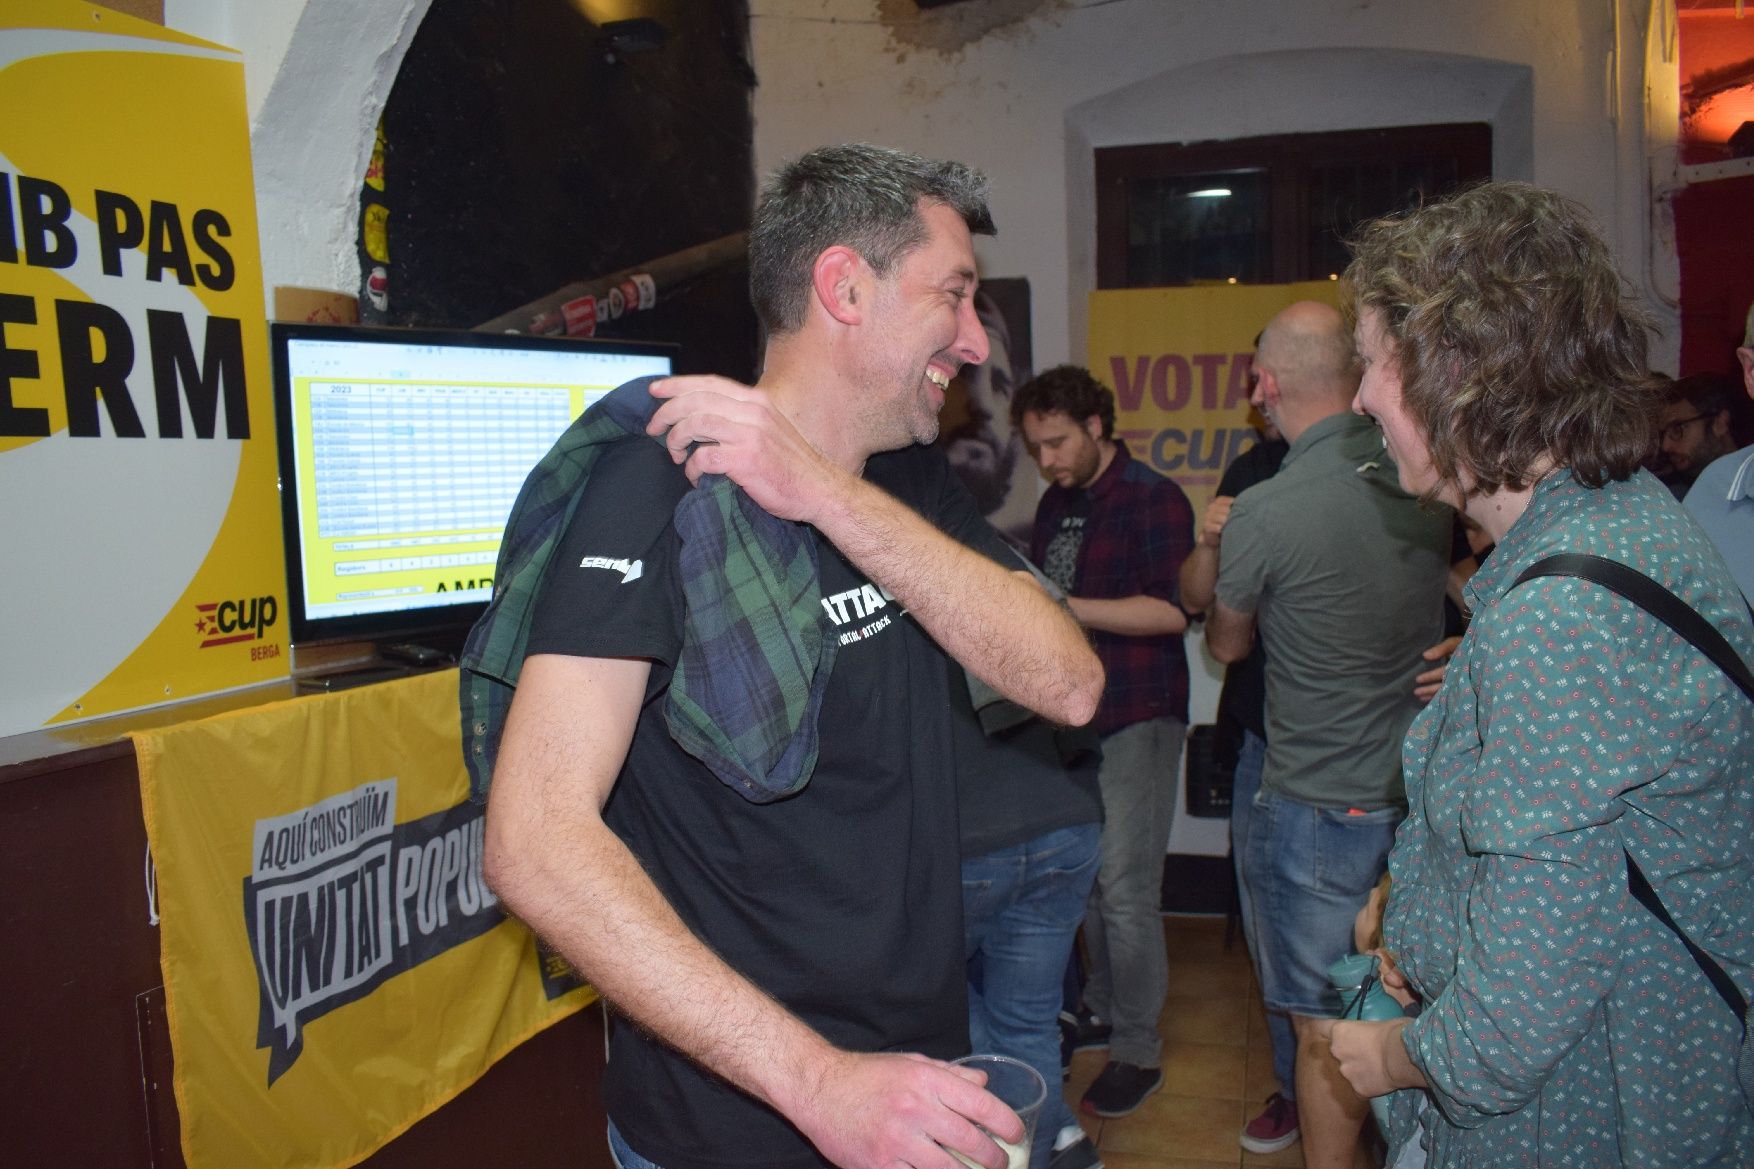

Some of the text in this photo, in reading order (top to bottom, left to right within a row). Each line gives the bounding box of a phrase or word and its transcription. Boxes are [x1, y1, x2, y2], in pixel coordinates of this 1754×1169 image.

[95, 189, 235, 292] PAS
[330, 385, 352, 394] 2023
[820, 583, 895, 626] TTA
[250, 643, 281, 662] BERGA
[838, 631, 861, 647] ORTAL
[259, 786, 389, 871] AQUÍ CONSTRUÏM
[264, 853, 387, 1011] UNITAT
